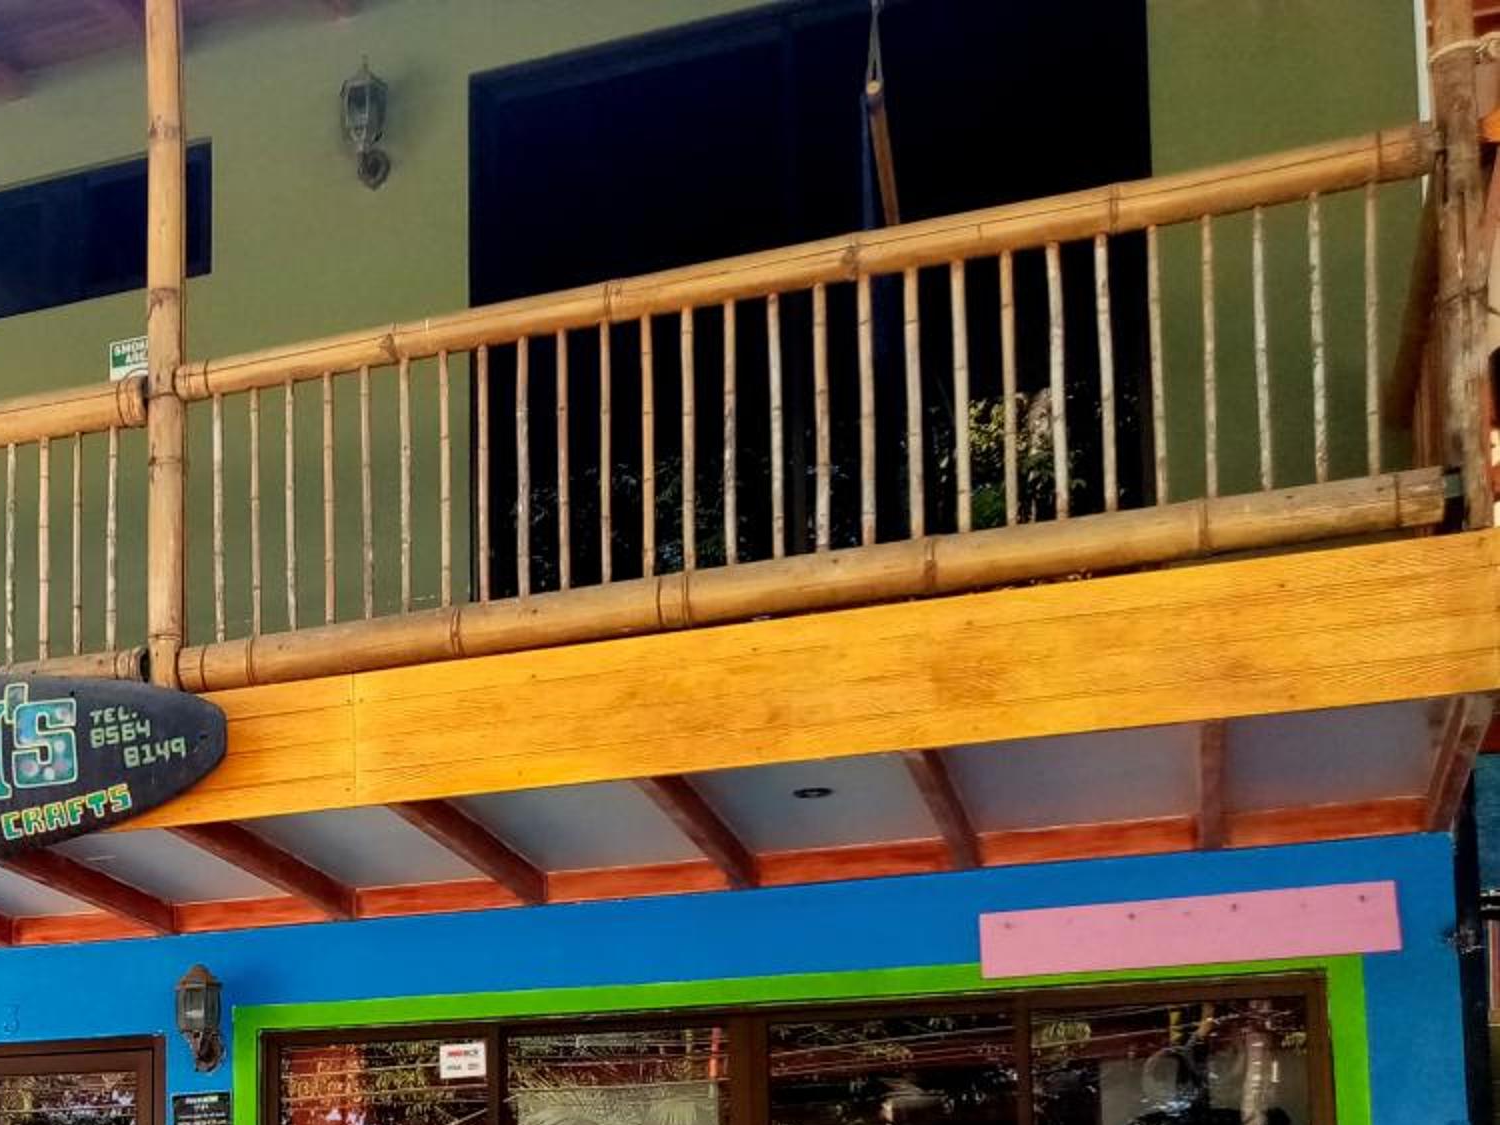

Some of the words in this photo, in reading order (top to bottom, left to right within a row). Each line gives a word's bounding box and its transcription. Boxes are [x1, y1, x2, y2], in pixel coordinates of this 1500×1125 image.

[90, 705, 138, 723] TEL.
[90, 719, 151, 749] 8564
[123, 736, 187, 768] 8149
[0, 783, 132, 841] CRAFTS
